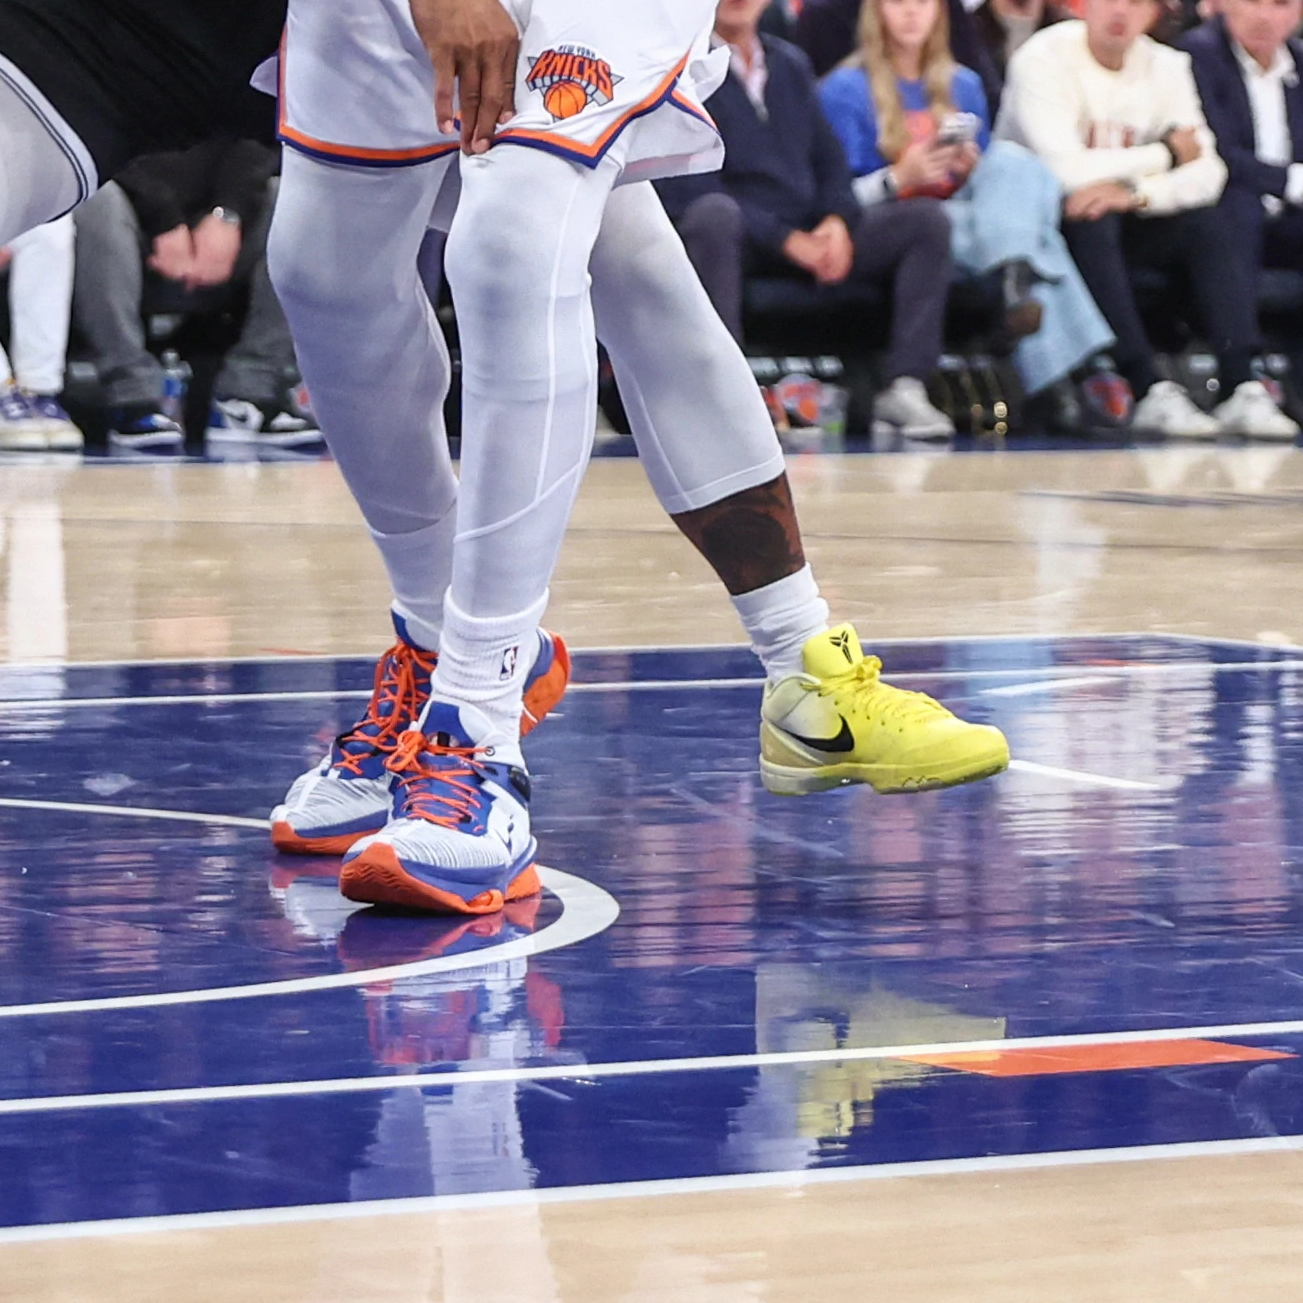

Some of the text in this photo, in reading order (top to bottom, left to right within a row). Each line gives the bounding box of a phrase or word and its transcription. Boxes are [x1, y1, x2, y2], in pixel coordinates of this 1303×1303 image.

[558, 44, 596, 61] NEW YORK
[526, 49, 613, 100] KNICKS
